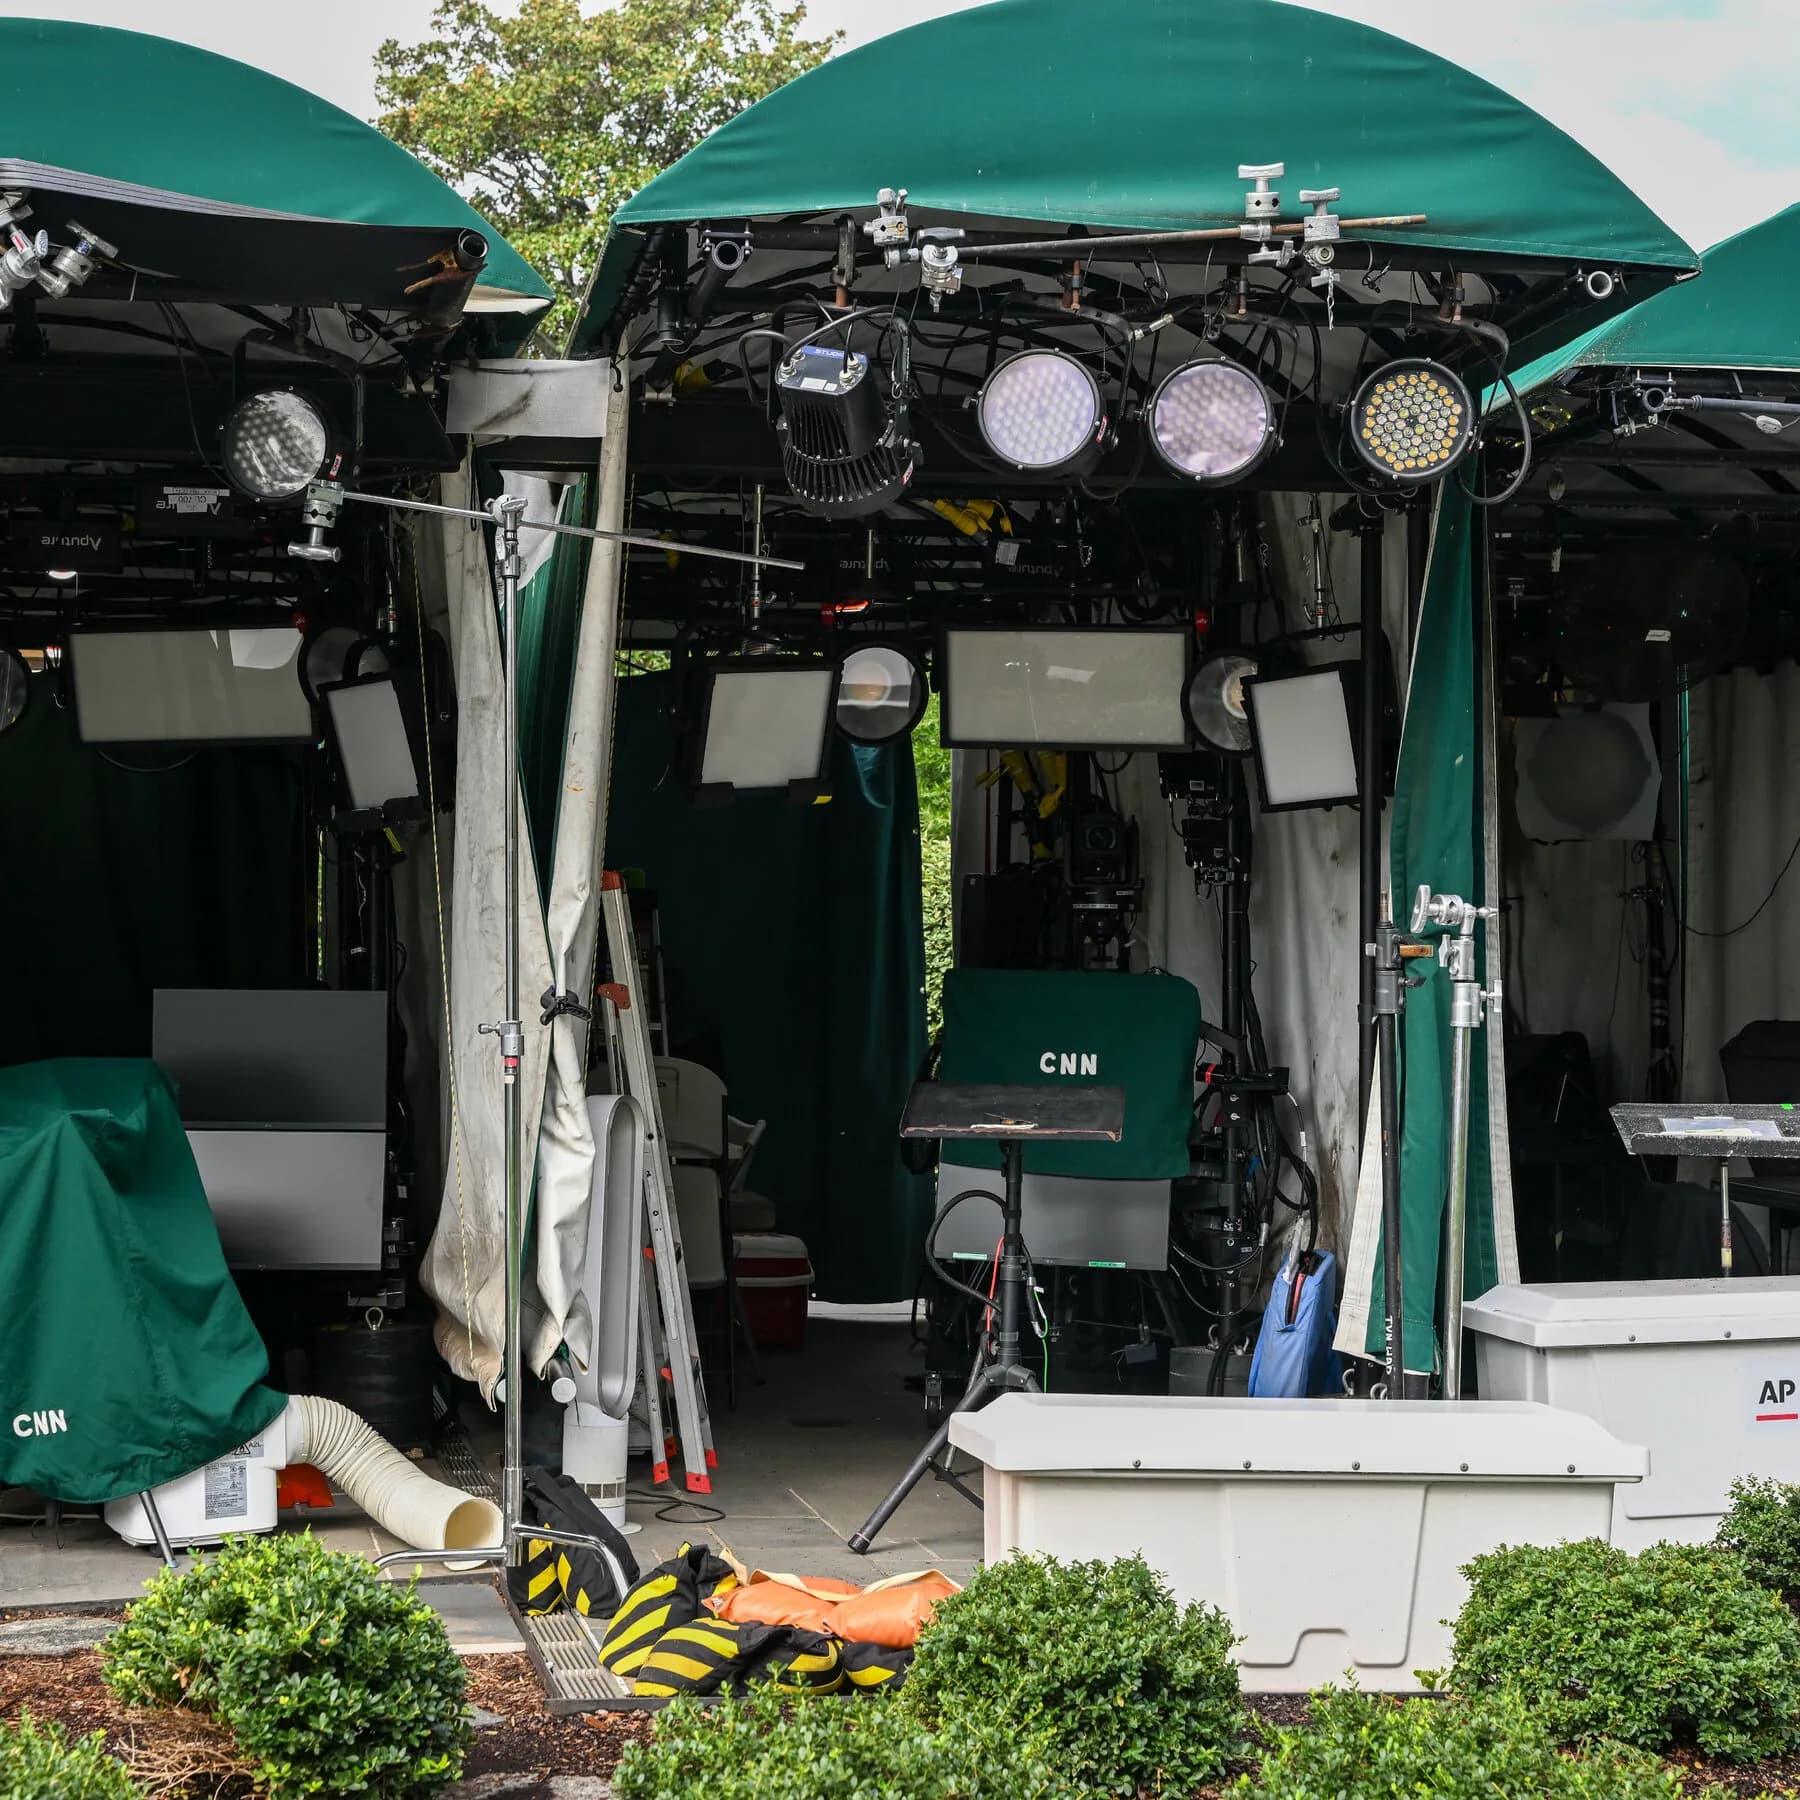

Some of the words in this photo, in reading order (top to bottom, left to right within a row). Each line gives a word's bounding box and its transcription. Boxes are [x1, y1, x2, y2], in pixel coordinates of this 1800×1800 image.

[1040, 1052, 1097, 1076] CNN
[1385, 1315, 1393, 1341] TVN
[1759, 1380, 1796, 1405] AP
[13, 1409, 68, 1438] CNN
